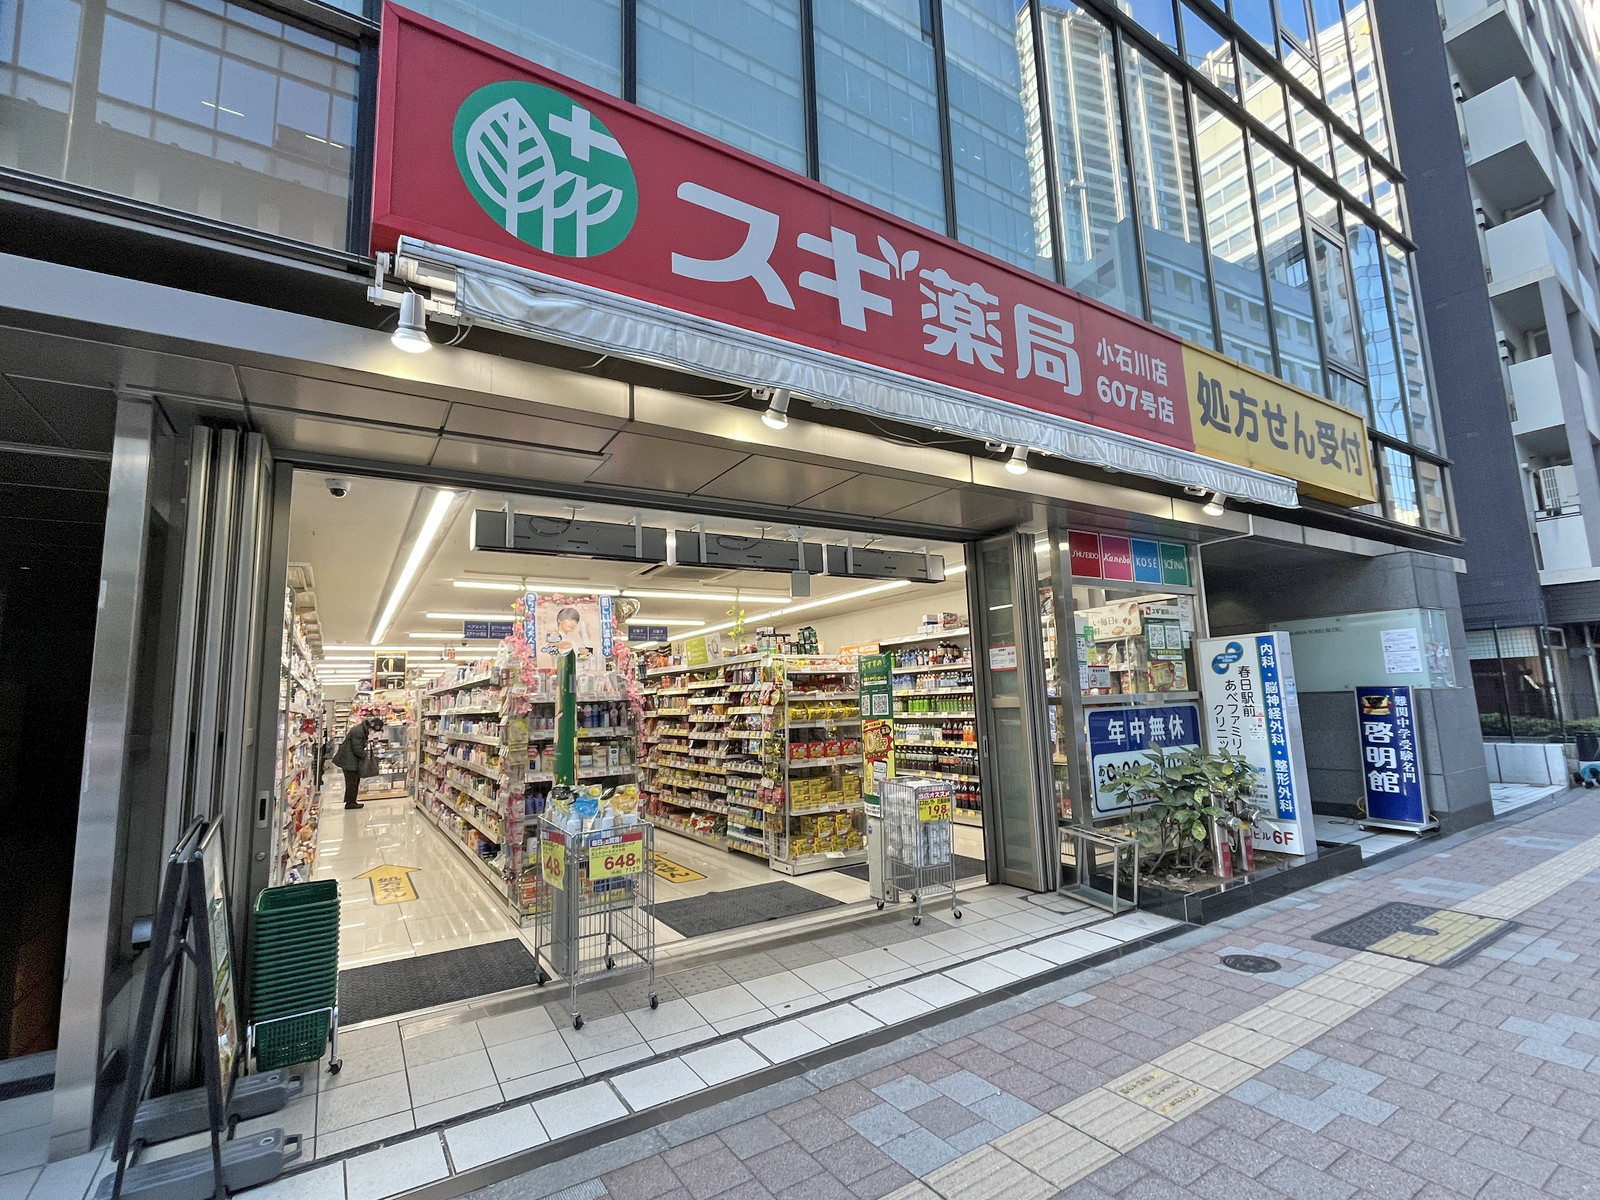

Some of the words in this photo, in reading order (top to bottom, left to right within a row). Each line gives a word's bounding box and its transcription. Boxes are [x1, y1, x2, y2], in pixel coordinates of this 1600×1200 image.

[671, 181, 1083, 397] スギ薬局
[1096, 337, 1169, 387] 小石川店
[1096, 375, 1175, 425] 607号店
[1196, 371, 1363, 477] 処方せん受付
[1072, 549, 1099, 560] SHISEIDO
[1103, 552, 1131, 565] Kanebo
[1238, 665, 1256, 717] 春日駅前
[1107, 714, 1185, 746] 年中無休
[1213, 704, 1229, 749] クリニッ
[1260, 643, 1294, 813] 内科・脳神経外科・整形外科
[1394, 695, 1416, 784] 難関中学受験名門
[1363, 721, 1400, 794] 啓明館
[1272, 830, 1294, 846] 6F
